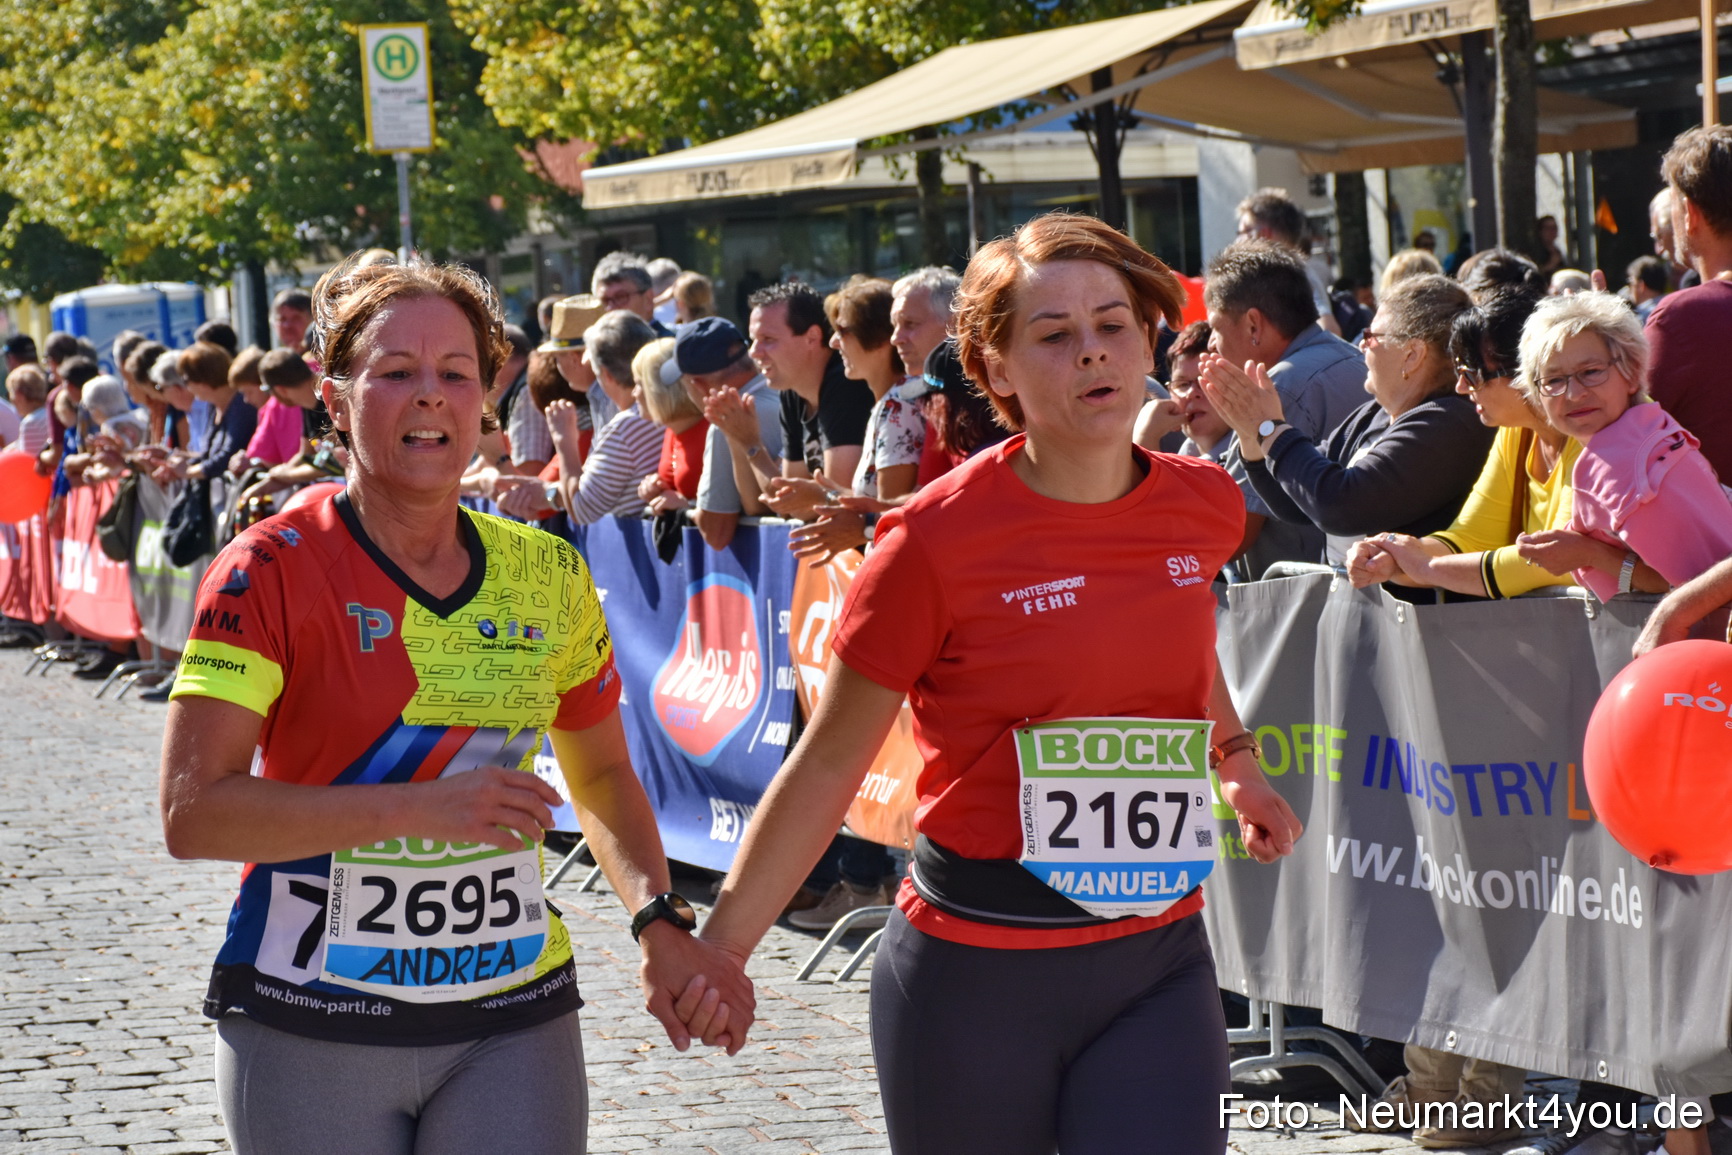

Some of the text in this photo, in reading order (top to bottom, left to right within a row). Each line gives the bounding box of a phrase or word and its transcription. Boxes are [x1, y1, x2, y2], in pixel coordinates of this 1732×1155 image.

[1166, 555, 1200, 577] SVS
[1015, 576, 1085, 600] INTERSPORT
[1022, 592, 1077, 615] FEHR
[1036, 730, 1193, 770] BOCK
[1046, 791, 1189, 850] 2167
[1049, 870, 1189, 896] MANUELA
[356, 867, 521, 937] 2695
[358, 940, 516, 986] ANDREA
